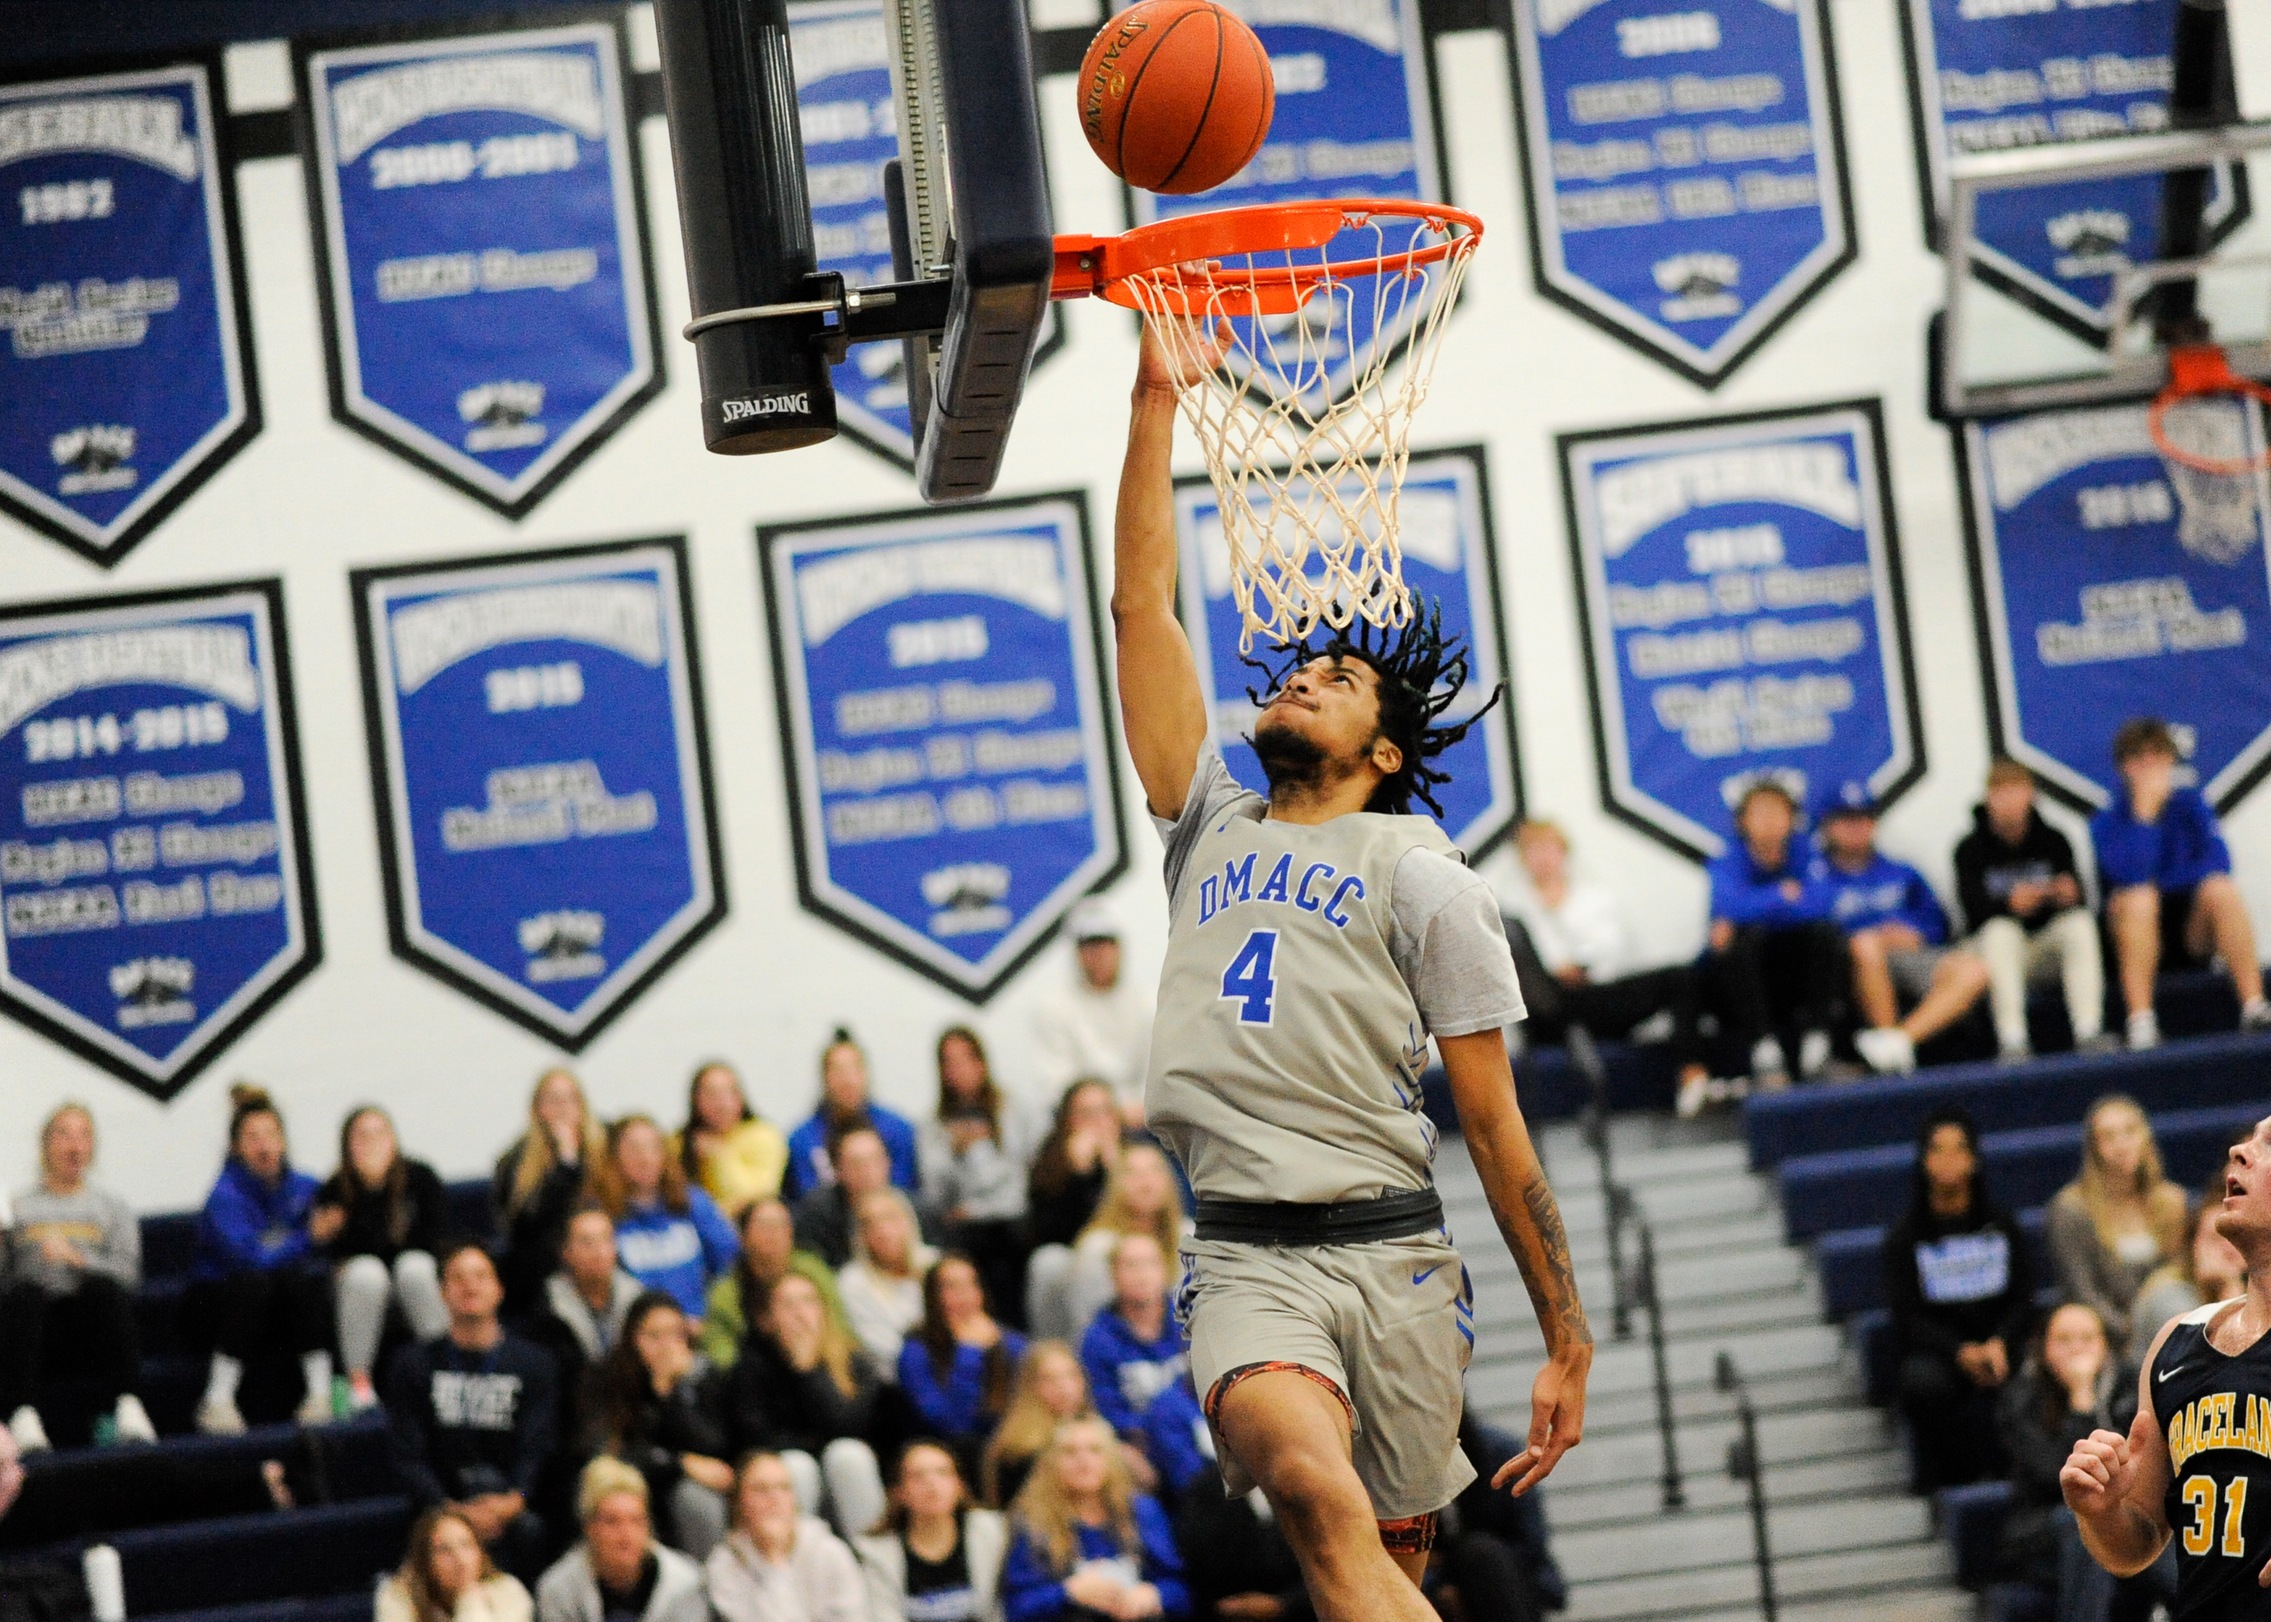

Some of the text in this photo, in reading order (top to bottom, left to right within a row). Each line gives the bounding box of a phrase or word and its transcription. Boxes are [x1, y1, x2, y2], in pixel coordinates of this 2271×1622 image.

[1086, 15, 1149, 144] SPALDING
[722, 392, 811, 424] SPALDING
[1196, 851, 1366, 930] DMACC
[1217, 928, 1281, 1029] 4
[2168, 1391, 2271, 1478] RACELAN
[2182, 1474, 2249, 1558] 31
